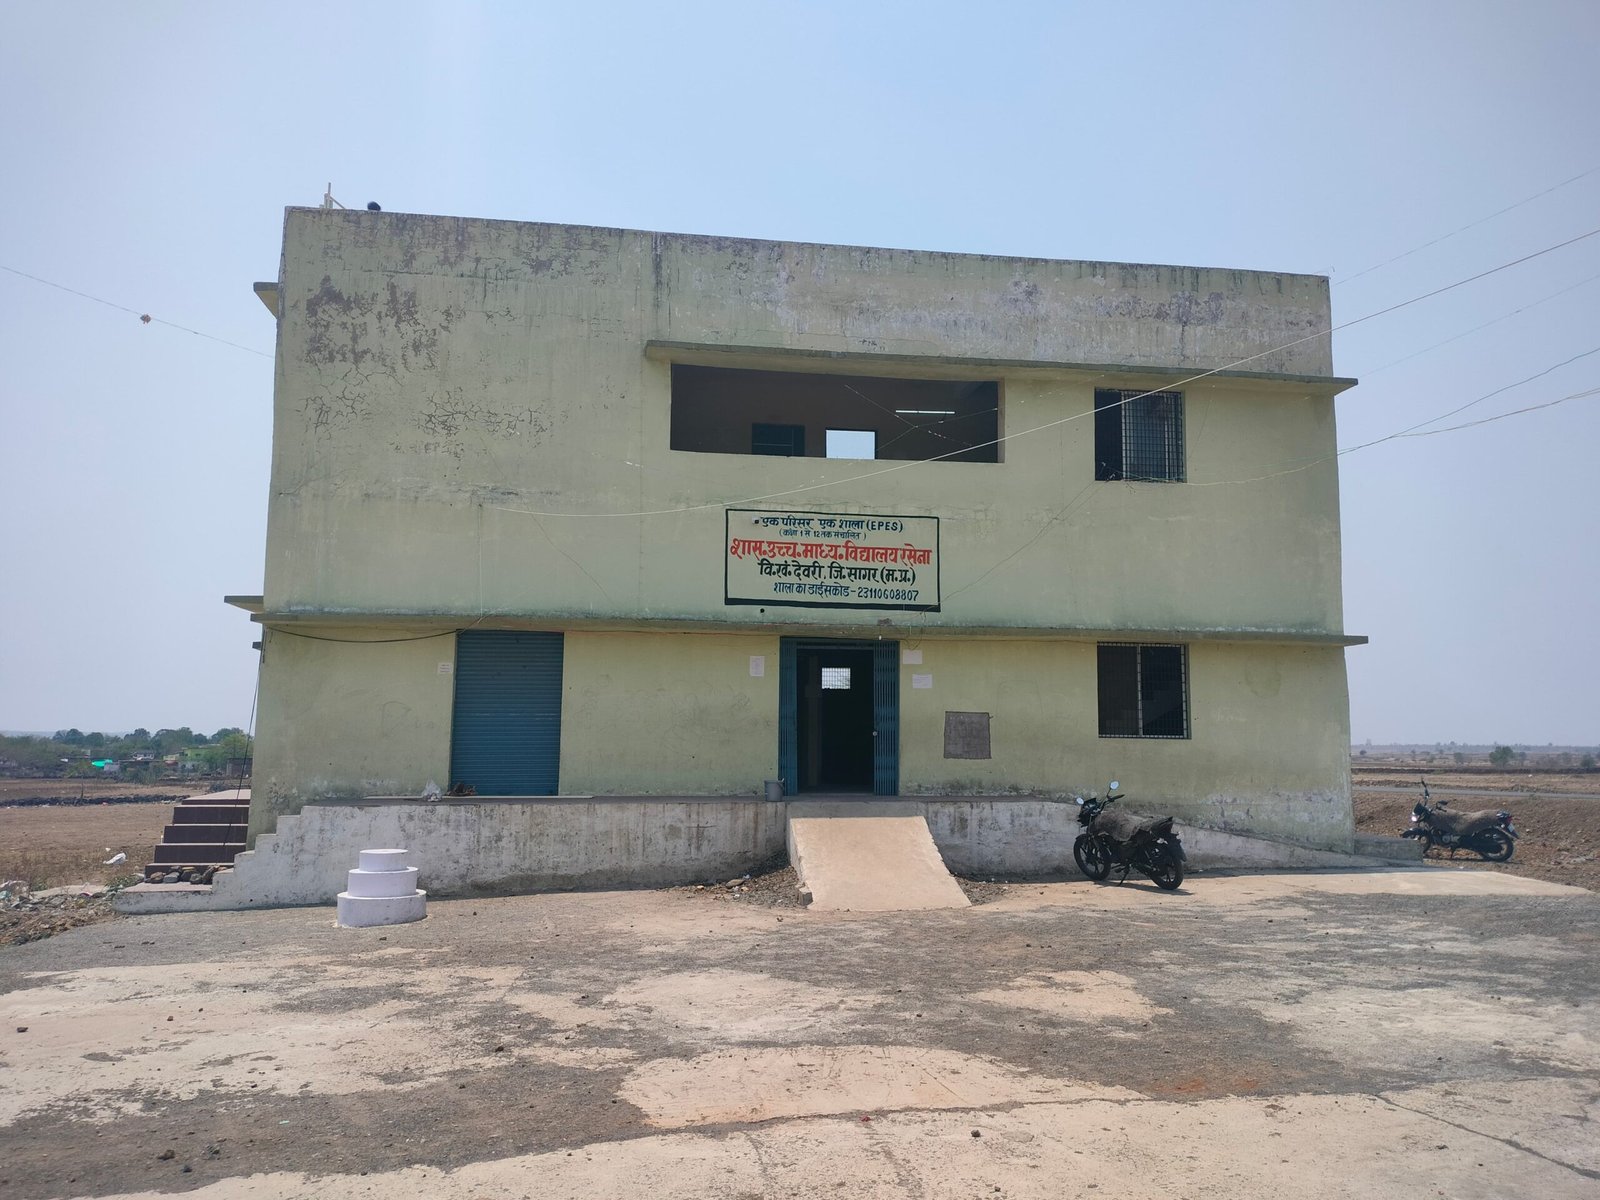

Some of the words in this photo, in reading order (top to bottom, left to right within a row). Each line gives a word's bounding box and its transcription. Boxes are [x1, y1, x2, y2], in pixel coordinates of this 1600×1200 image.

[760, 516, 780, 528] एक
[780, 514, 814, 530] परिसर
[817, 518, 837, 530] एक
[838, 518, 865, 531] शाला
[866, 519, 904, 533] (EPES)
[773, 581, 795, 594] शाला
[795, 582, 807, 595] का
